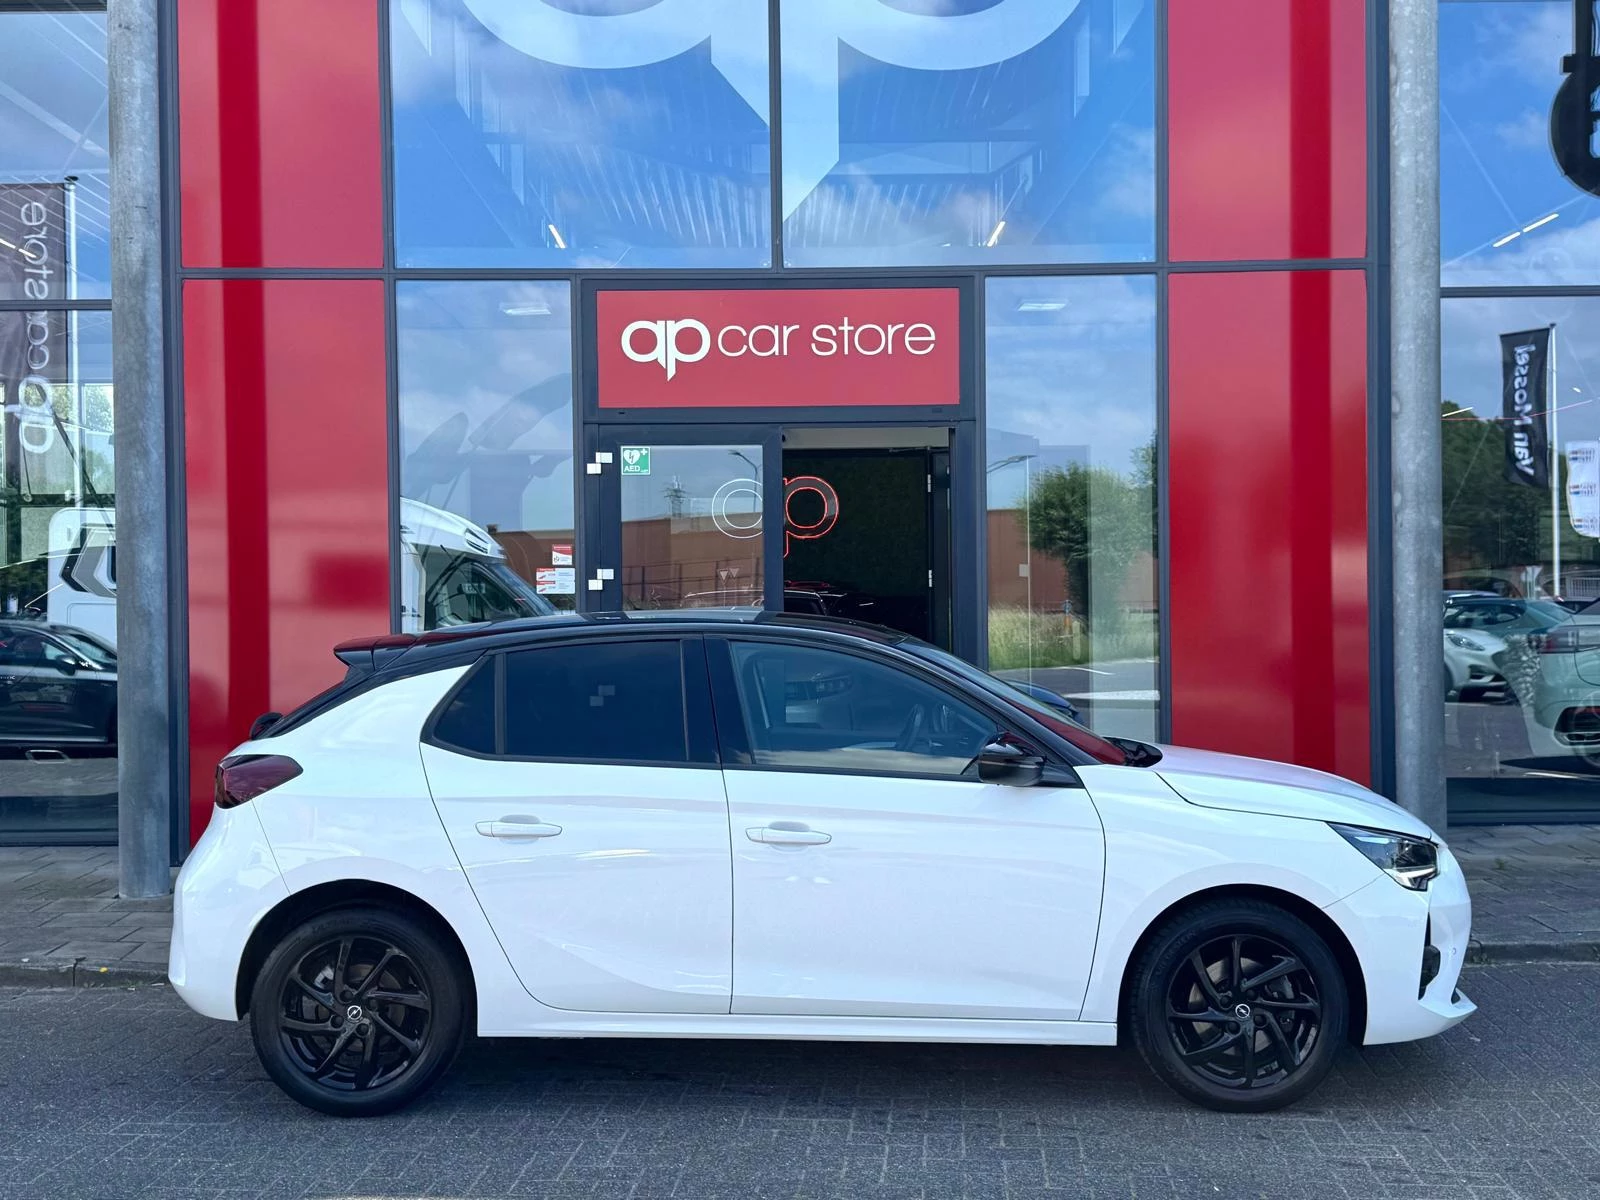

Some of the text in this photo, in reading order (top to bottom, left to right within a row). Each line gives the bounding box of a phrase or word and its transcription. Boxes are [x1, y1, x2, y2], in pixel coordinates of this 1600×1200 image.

[621, 316, 936, 382] ap car store
